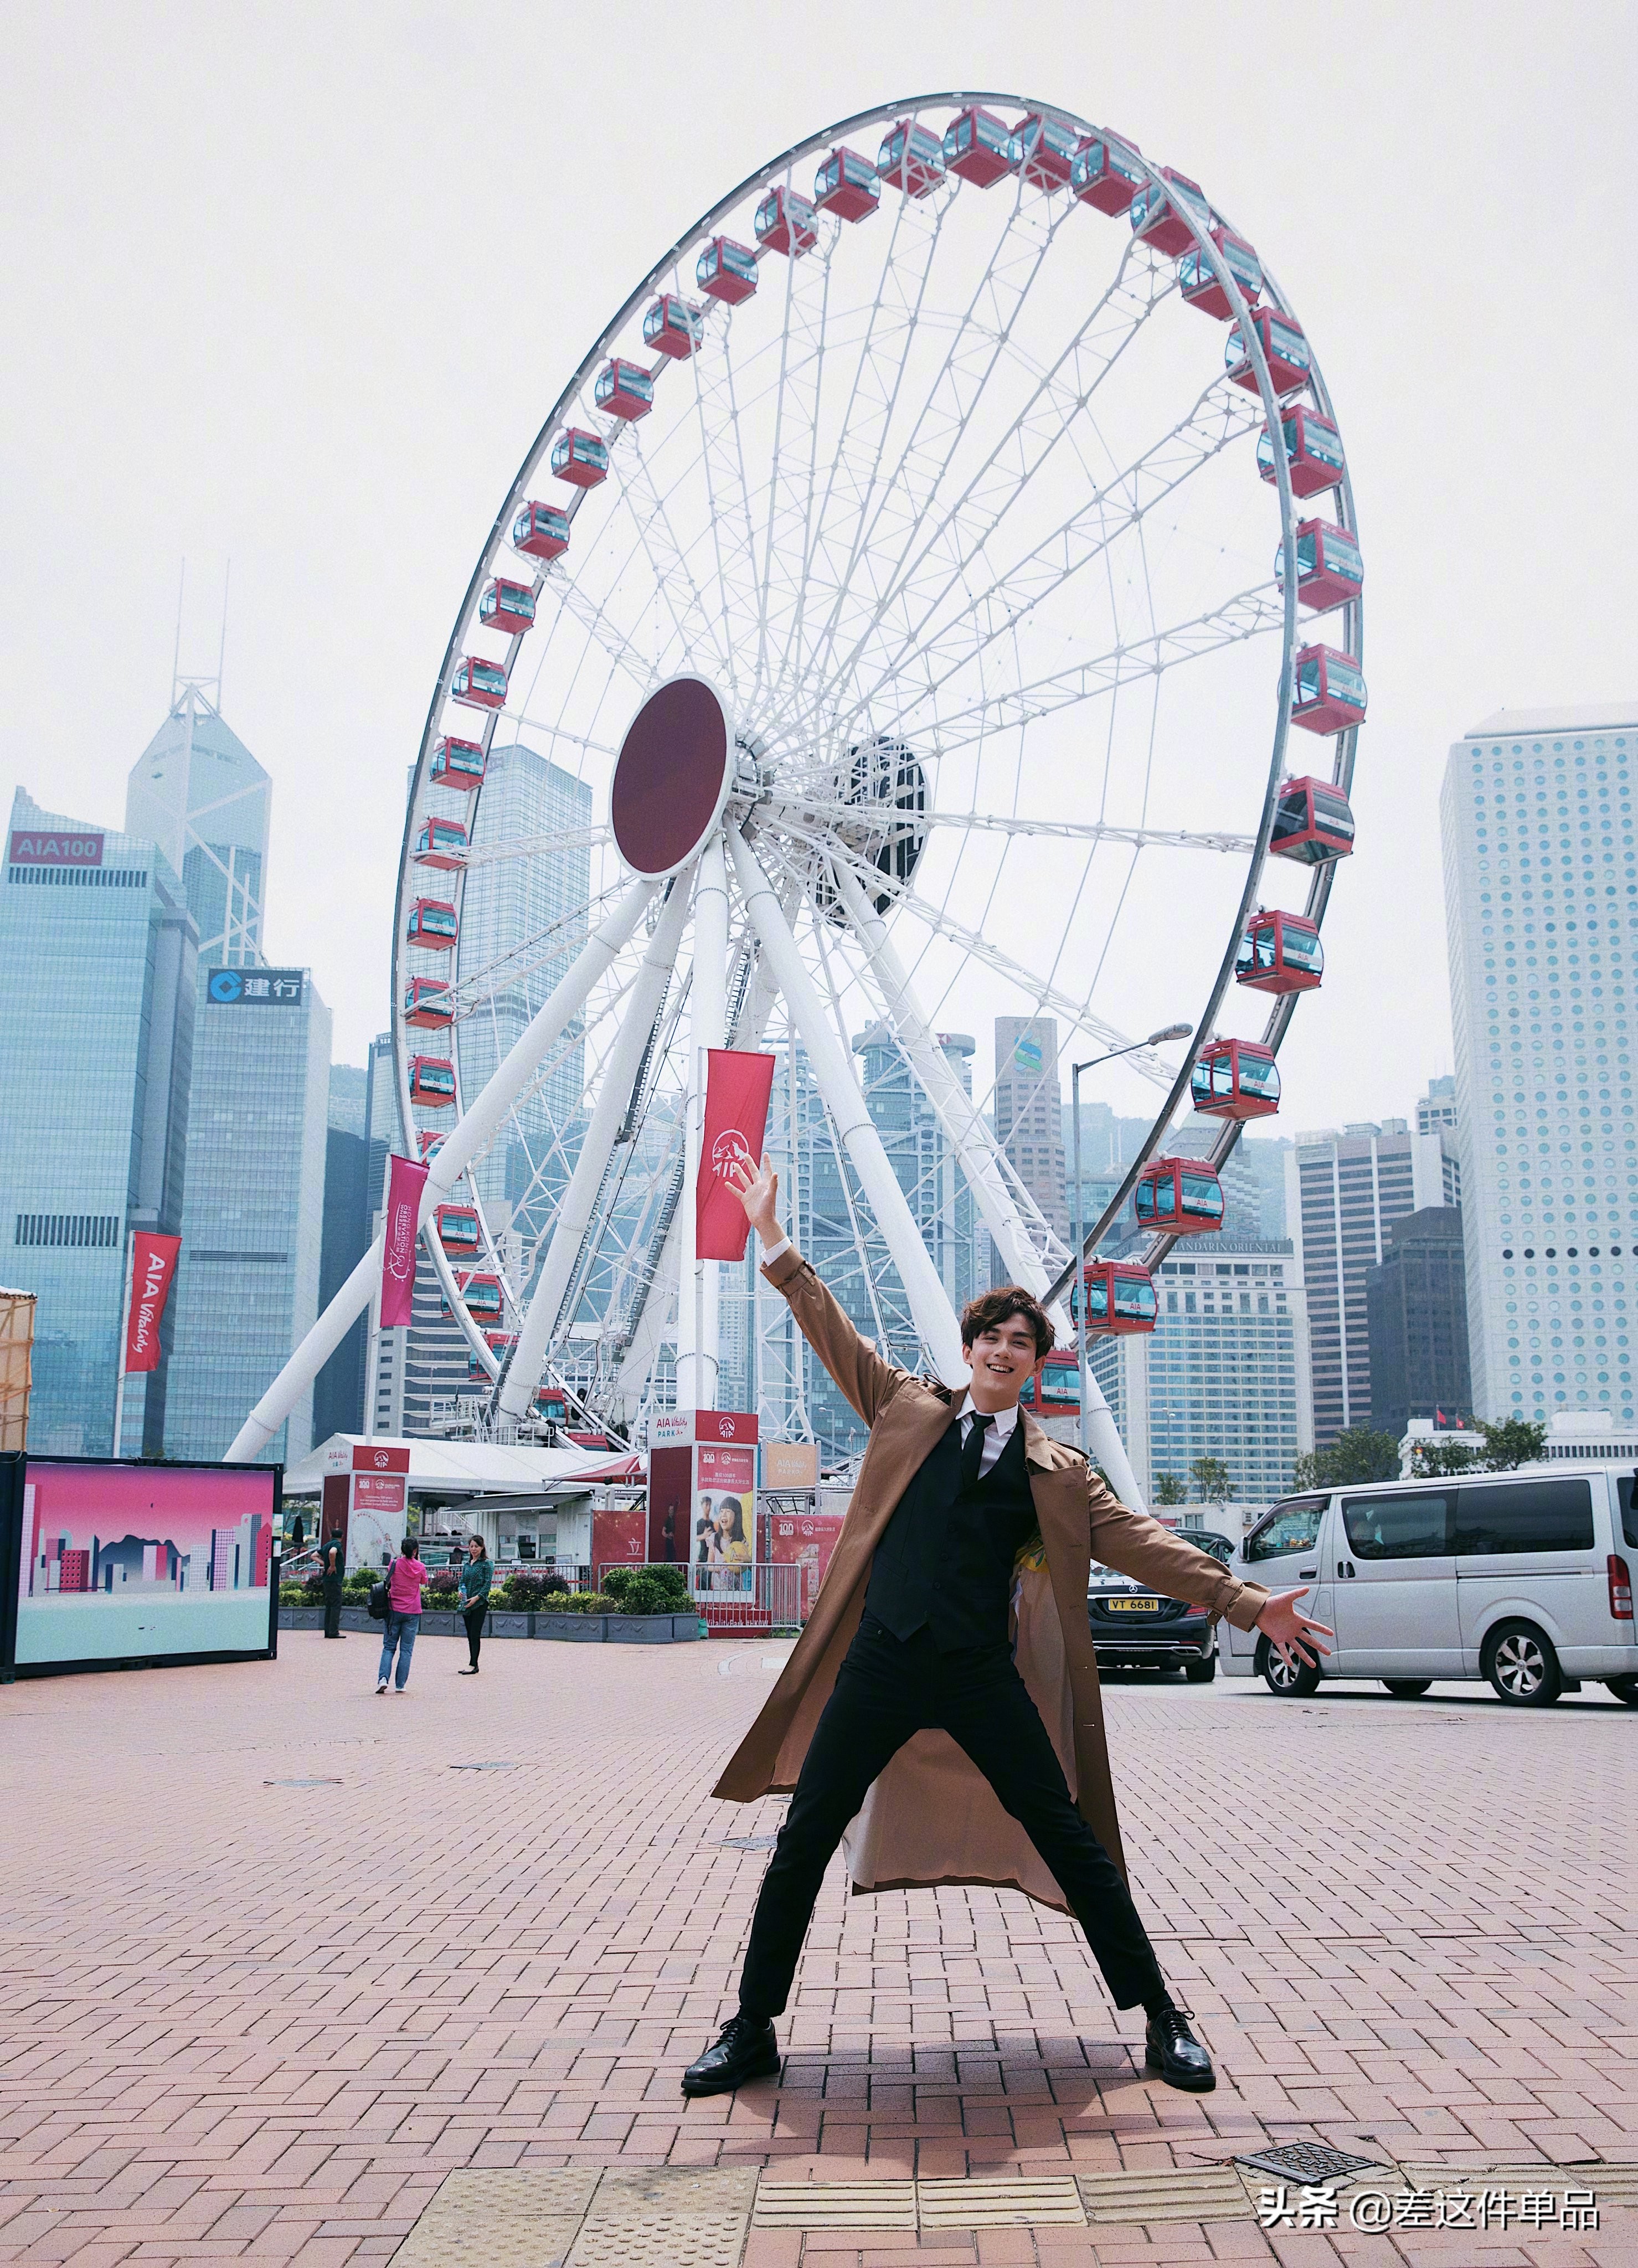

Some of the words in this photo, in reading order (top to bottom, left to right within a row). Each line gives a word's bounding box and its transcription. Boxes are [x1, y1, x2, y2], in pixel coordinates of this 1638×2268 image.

[17, 838, 97, 858] AIA100
[244, 978, 300, 998] 建行
[1254, 1081, 1265, 1089] AIA
[1172, 1242, 1227, 1251] MANDARIN
[1229, 1243, 1280, 1252] ORIENTAL
[142, 1252, 165, 1300] AIA
[132, 1302, 154, 1353] Vitality
[656, 1418, 671, 1428] AIA
[672, 1415, 687, 1428] Vitality
[1112, 1600, 1126, 1609] VT
[1130, 1601, 1154, 1610] 6681
